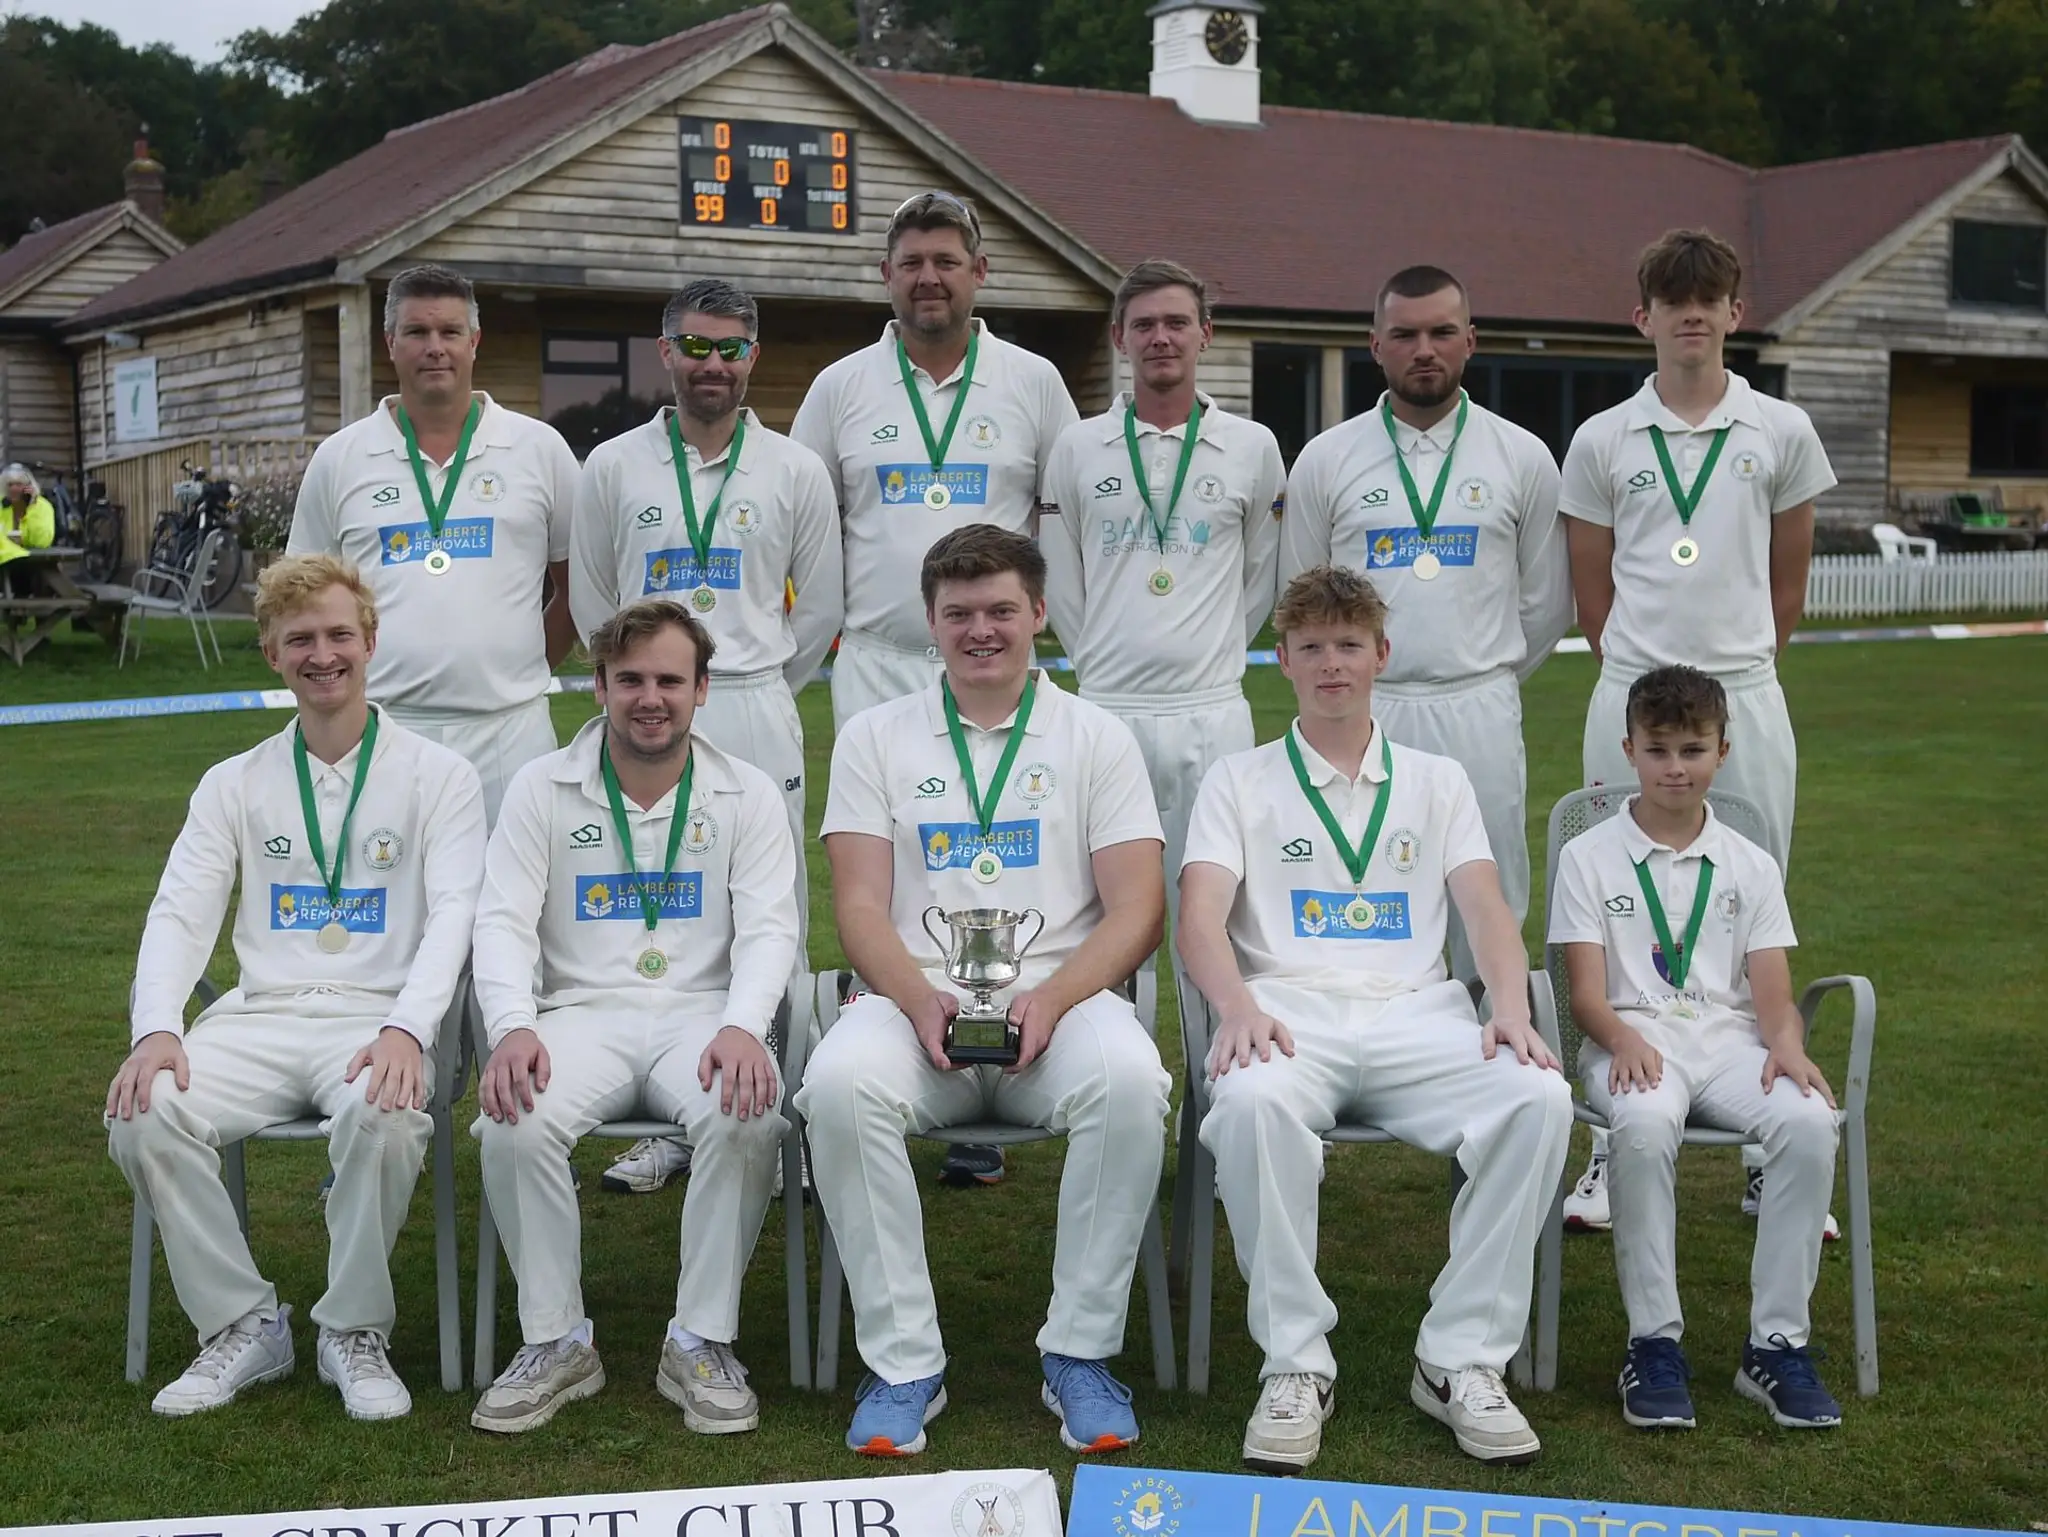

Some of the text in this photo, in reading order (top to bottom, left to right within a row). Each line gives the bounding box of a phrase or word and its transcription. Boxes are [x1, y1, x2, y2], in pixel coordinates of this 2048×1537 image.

[714, 122, 730, 149] 0
[831, 132, 847, 158] 0
[748, 145, 789, 159] TOTAL
[715, 155, 731, 181] 0
[774, 159, 790, 186] 0
[831, 163, 847, 190] 0
[695, 195, 724, 222] 99
[761, 198, 776, 225] 0
[831, 203, 847, 229] 0
[909, 483, 981, 494] REVALS
[415, 525, 487, 540] LABERTS
[673, 556, 737, 568] LAMERTS
[301, 908, 378, 922] REMOVALS
[618, 895, 695, 909] REOVALS
[1328, 902, 1403, 915] LAERTS
[1330, 915, 1404, 929] REVALS
[1113, 1477, 1183, 1510] LAMBERTS
[676, 1498, 900, 1537] CLUB
